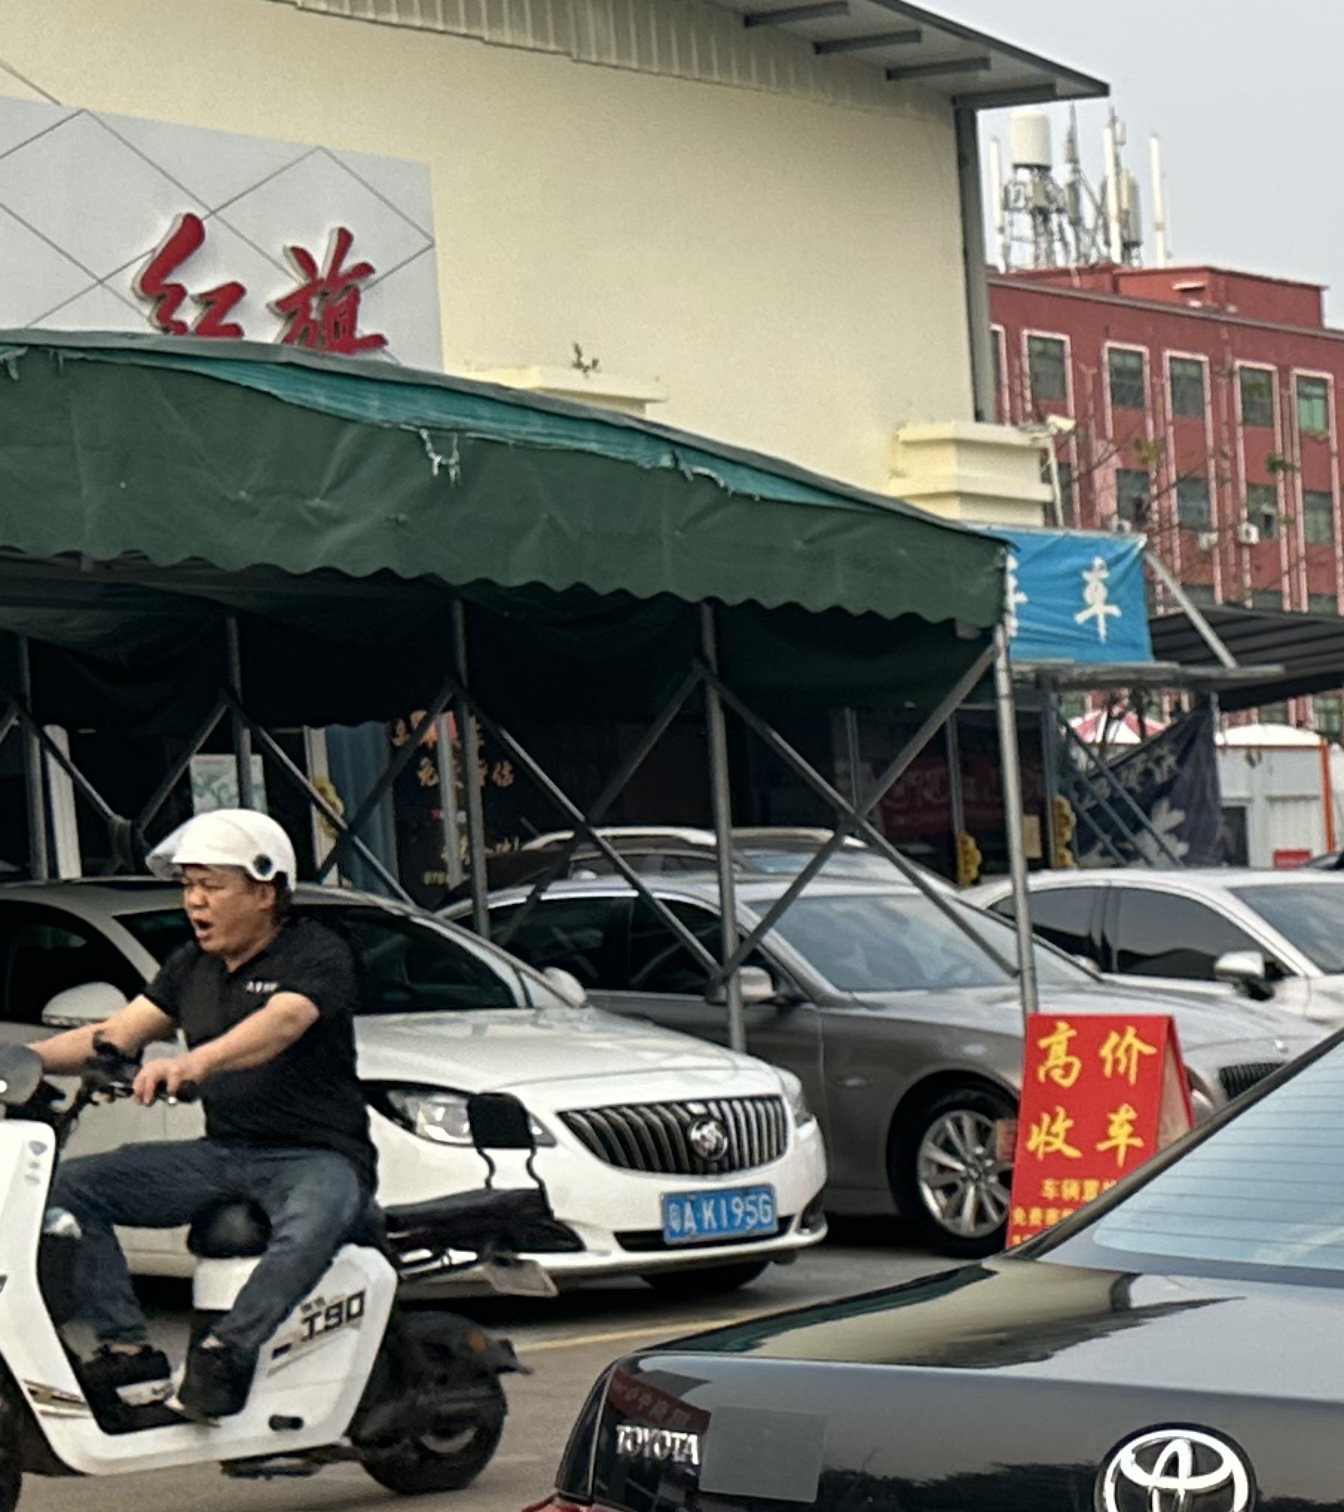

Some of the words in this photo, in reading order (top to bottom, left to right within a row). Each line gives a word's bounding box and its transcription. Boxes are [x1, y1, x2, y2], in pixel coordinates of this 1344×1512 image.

[135, 212, 388, 355] 红旗
[1036, 1021, 1158, 1088] 高价
[1026, 1103, 1146, 1169] 收车
[616, 1424, 700, 1466] TOYOTA
